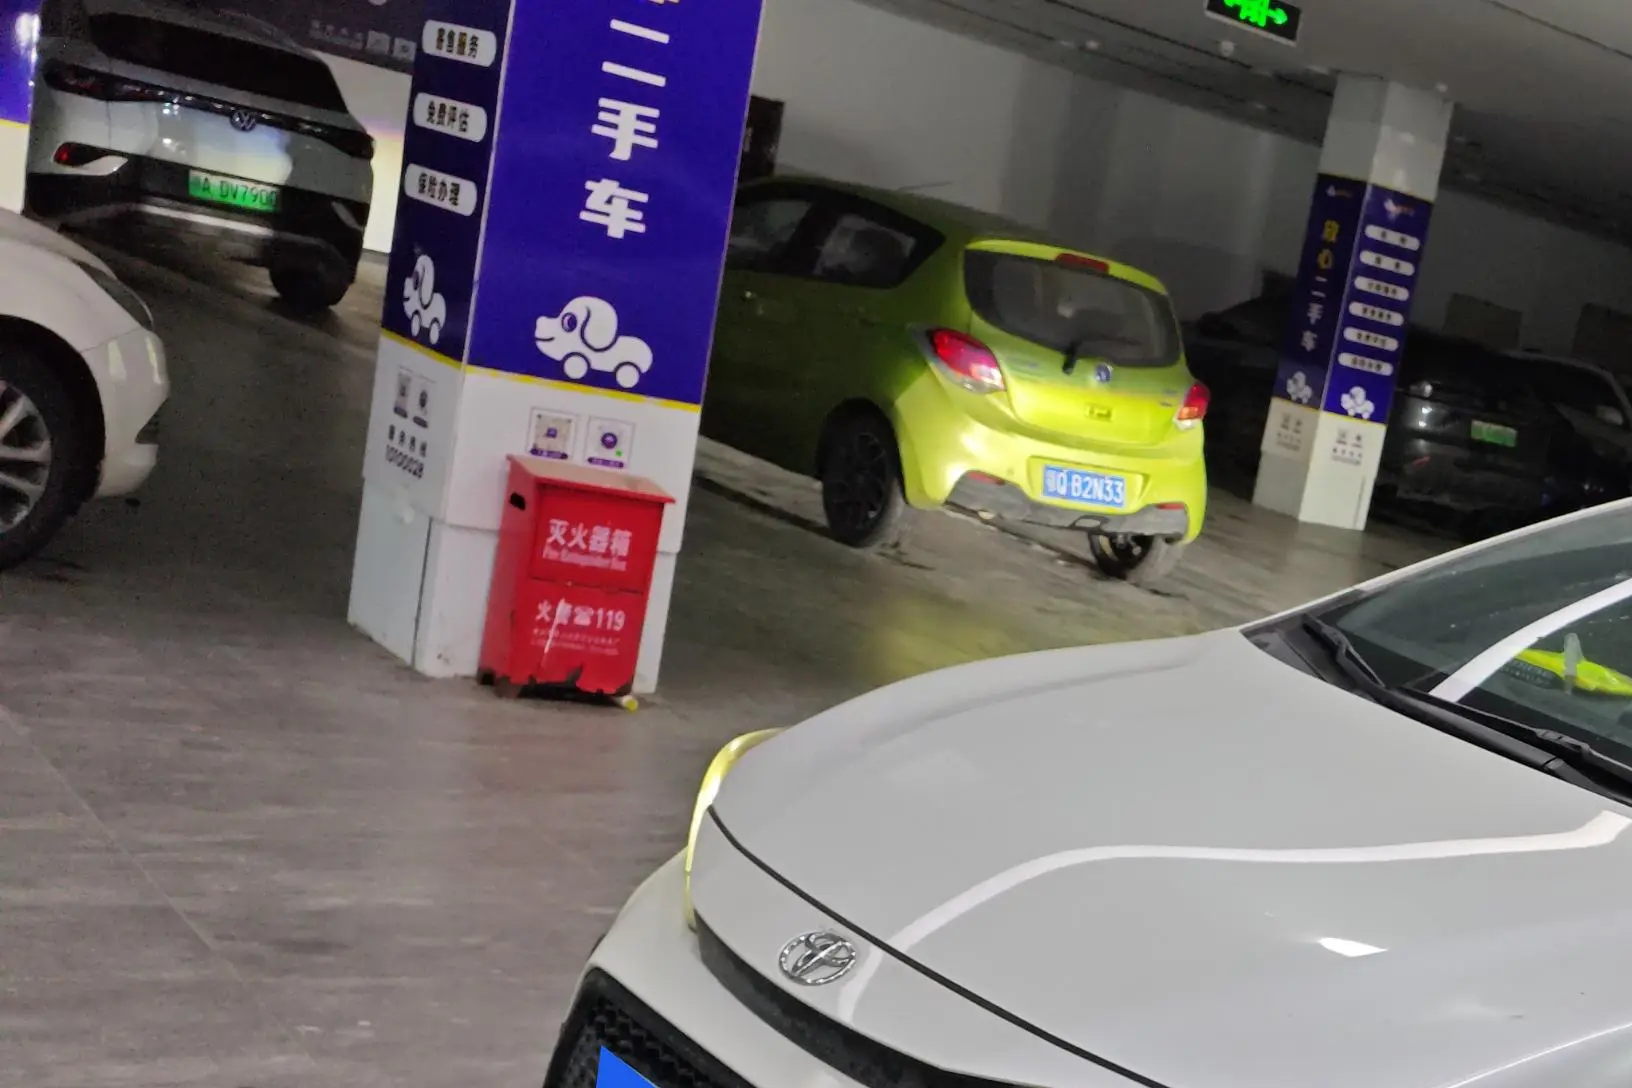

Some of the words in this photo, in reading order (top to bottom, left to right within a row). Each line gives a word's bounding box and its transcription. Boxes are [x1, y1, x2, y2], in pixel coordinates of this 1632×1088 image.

[579, 0, 680, 240] 二手车
[546, 518, 633, 557] 灭火器箱
[595, 606, 626, 632] 119
